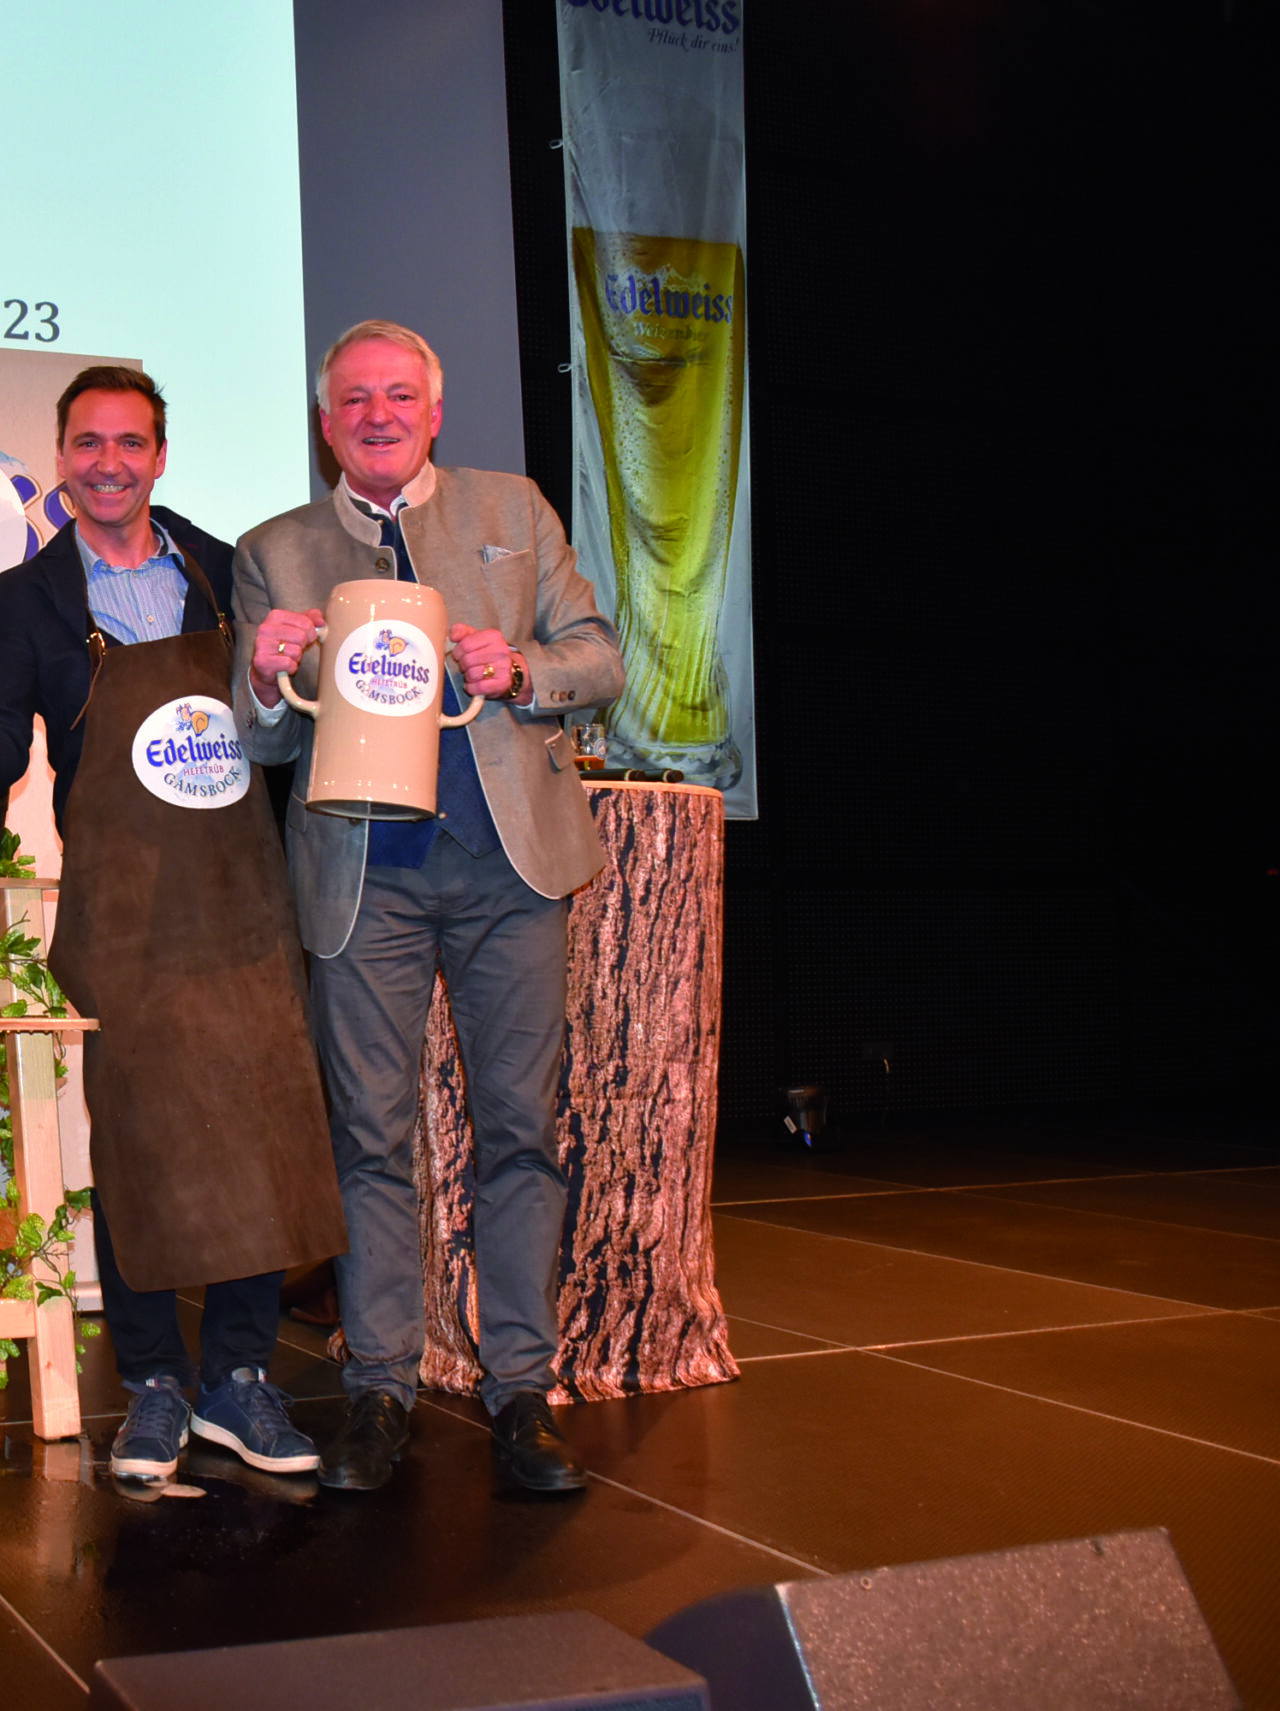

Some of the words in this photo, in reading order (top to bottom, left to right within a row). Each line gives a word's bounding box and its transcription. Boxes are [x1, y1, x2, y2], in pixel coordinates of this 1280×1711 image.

[691, 35, 710, 51] dir
[711, 37, 740, 54] eins!
[348, 652, 430, 684] Edelweiss
[356, 679, 423, 705] GAMSBOCK
[146, 733, 242, 768] Edelweiss
[163, 765, 241, 798] GAMSBOCK
[183, 764, 225, 777] HEFETRÜB
